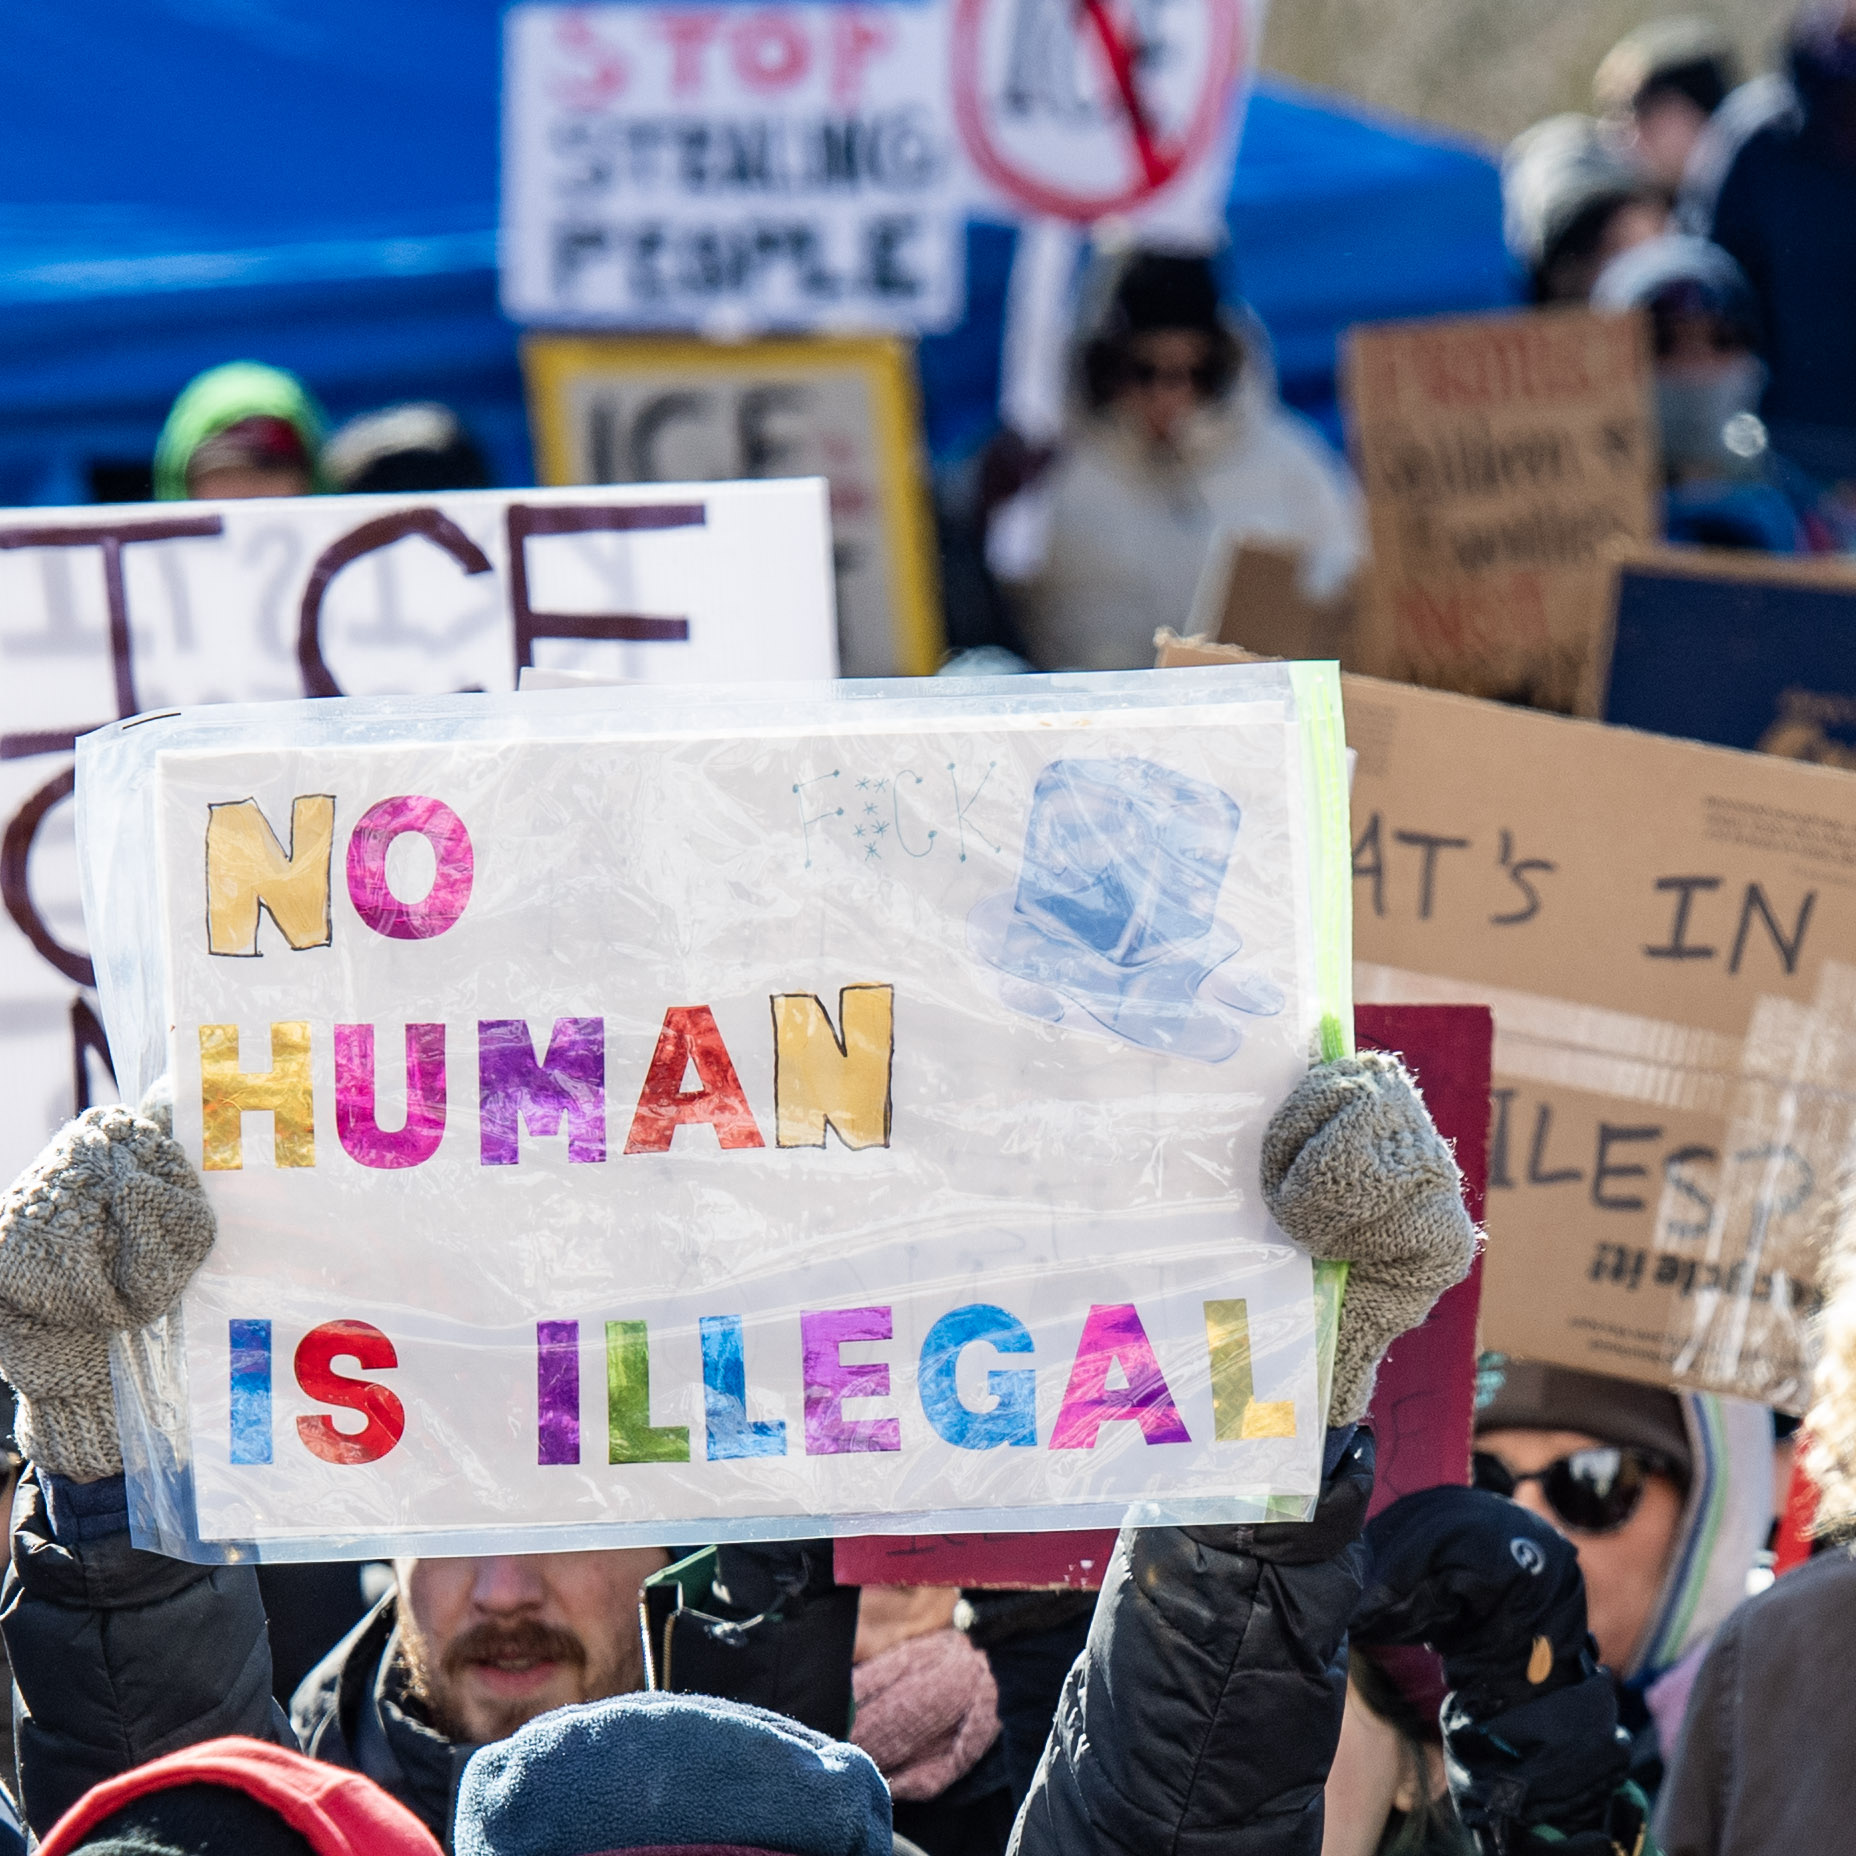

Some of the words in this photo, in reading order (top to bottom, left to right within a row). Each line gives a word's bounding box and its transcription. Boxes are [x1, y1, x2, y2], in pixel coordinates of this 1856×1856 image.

[548, 12, 894, 110] STOP
[552, 212, 924, 300] PEOPLE
[581, 383, 814, 485] ICE
[204, 793, 476, 957] NO
[1643, 876, 1820, 976] IN
[198, 981, 895, 1172] HUMAN
[227, 1317, 408, 1466] IS
[535, 1297, 1297, 1467] ILLEGAL
